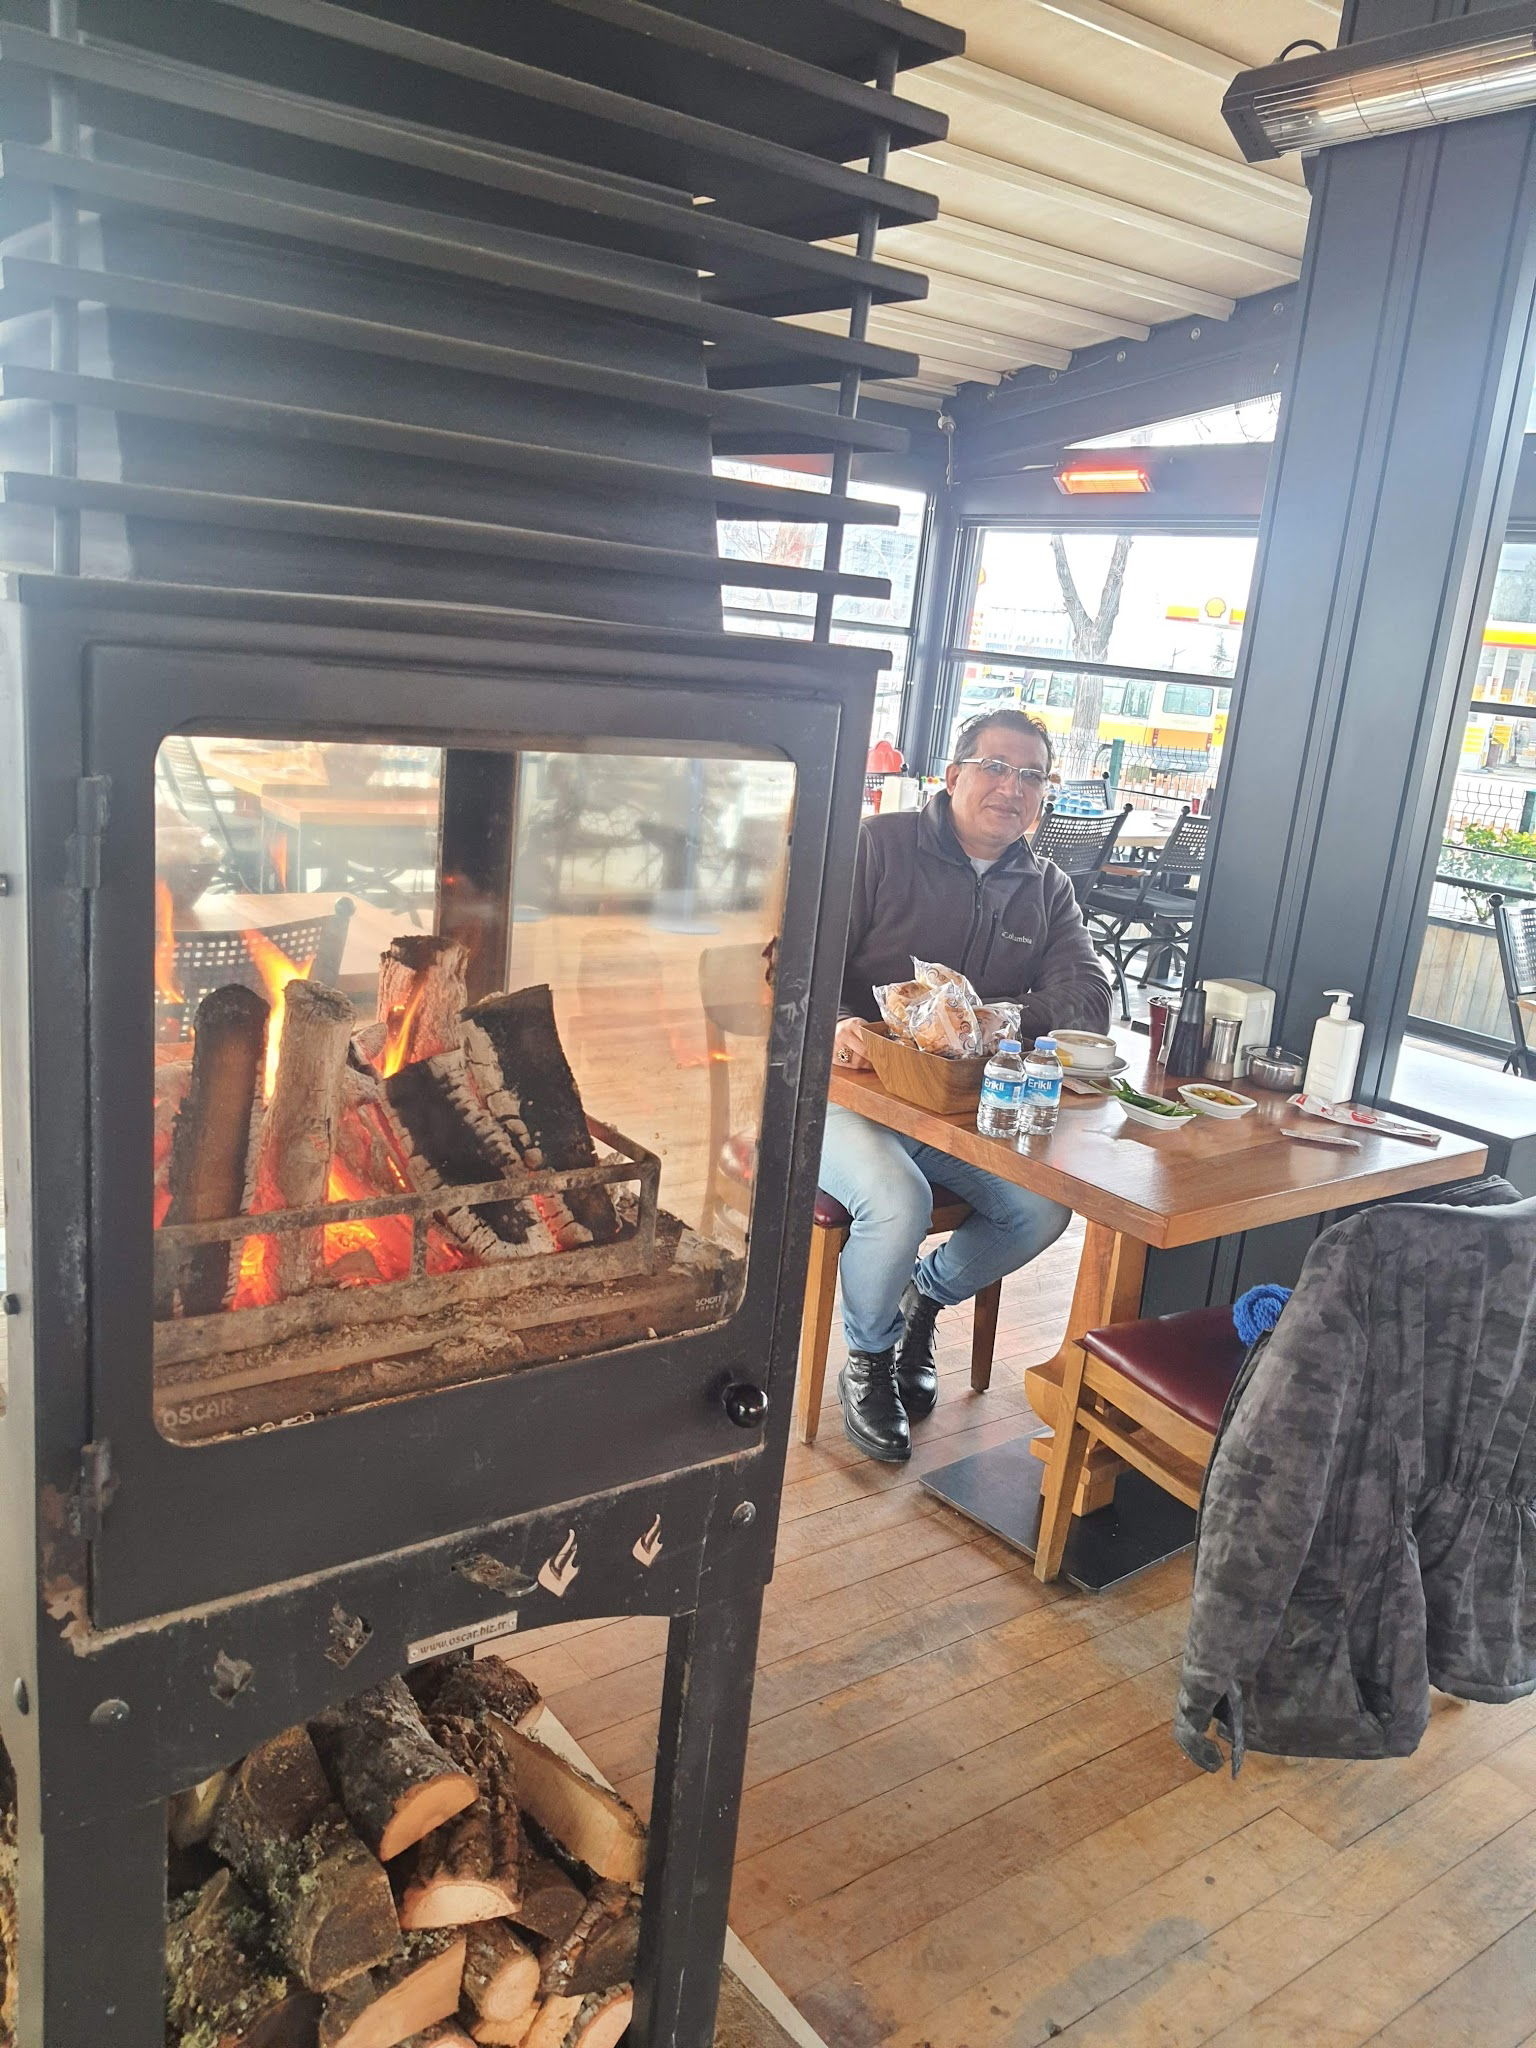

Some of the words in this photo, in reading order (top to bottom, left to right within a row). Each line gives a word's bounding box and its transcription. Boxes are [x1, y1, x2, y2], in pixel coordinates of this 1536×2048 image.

[984, 1078, 1005, 1091] Erikli
[1028, 1078, 1052, 1091] Erikli
[163, 1398, 236, 1427] OSCAR
